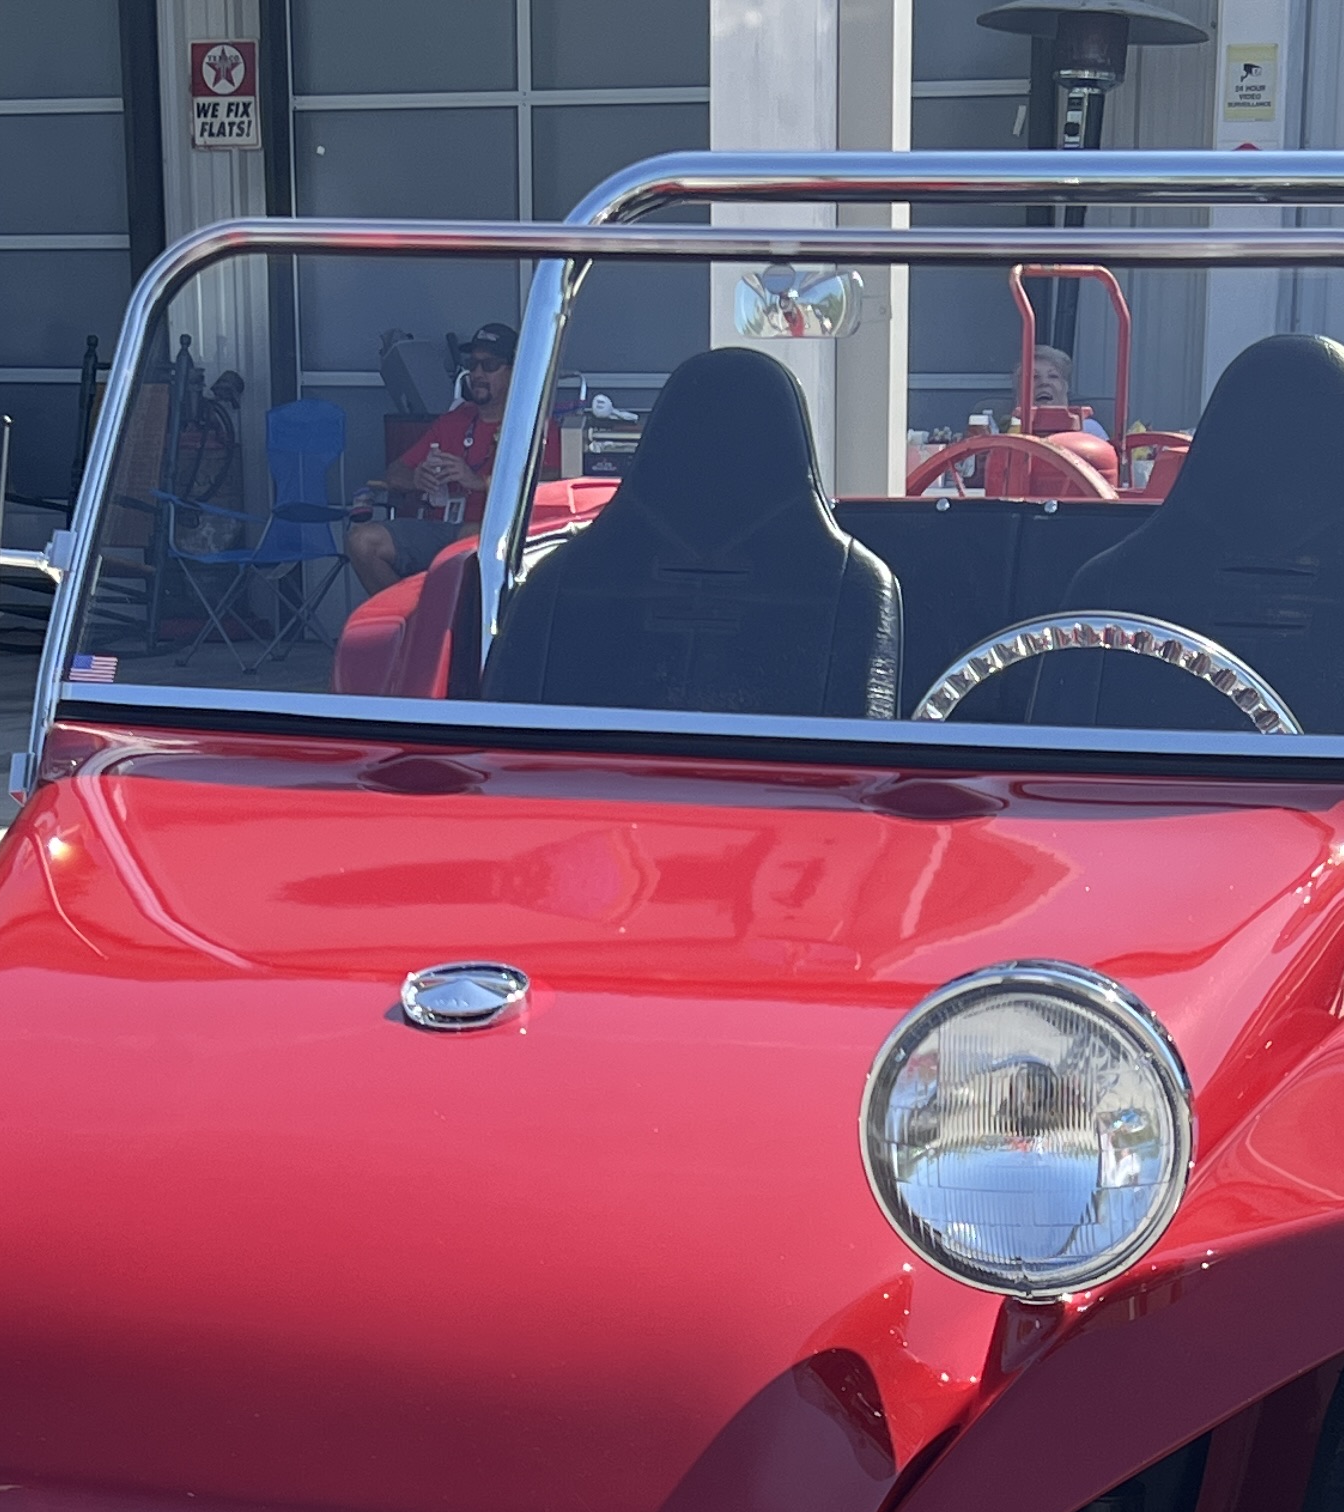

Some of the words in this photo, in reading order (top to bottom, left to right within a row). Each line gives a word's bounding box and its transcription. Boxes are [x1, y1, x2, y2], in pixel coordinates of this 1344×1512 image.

[196, 102, 220, 118] WE
[226, 101, 252, 118] FIX
[199, 120, 252, 137] FLATS!
